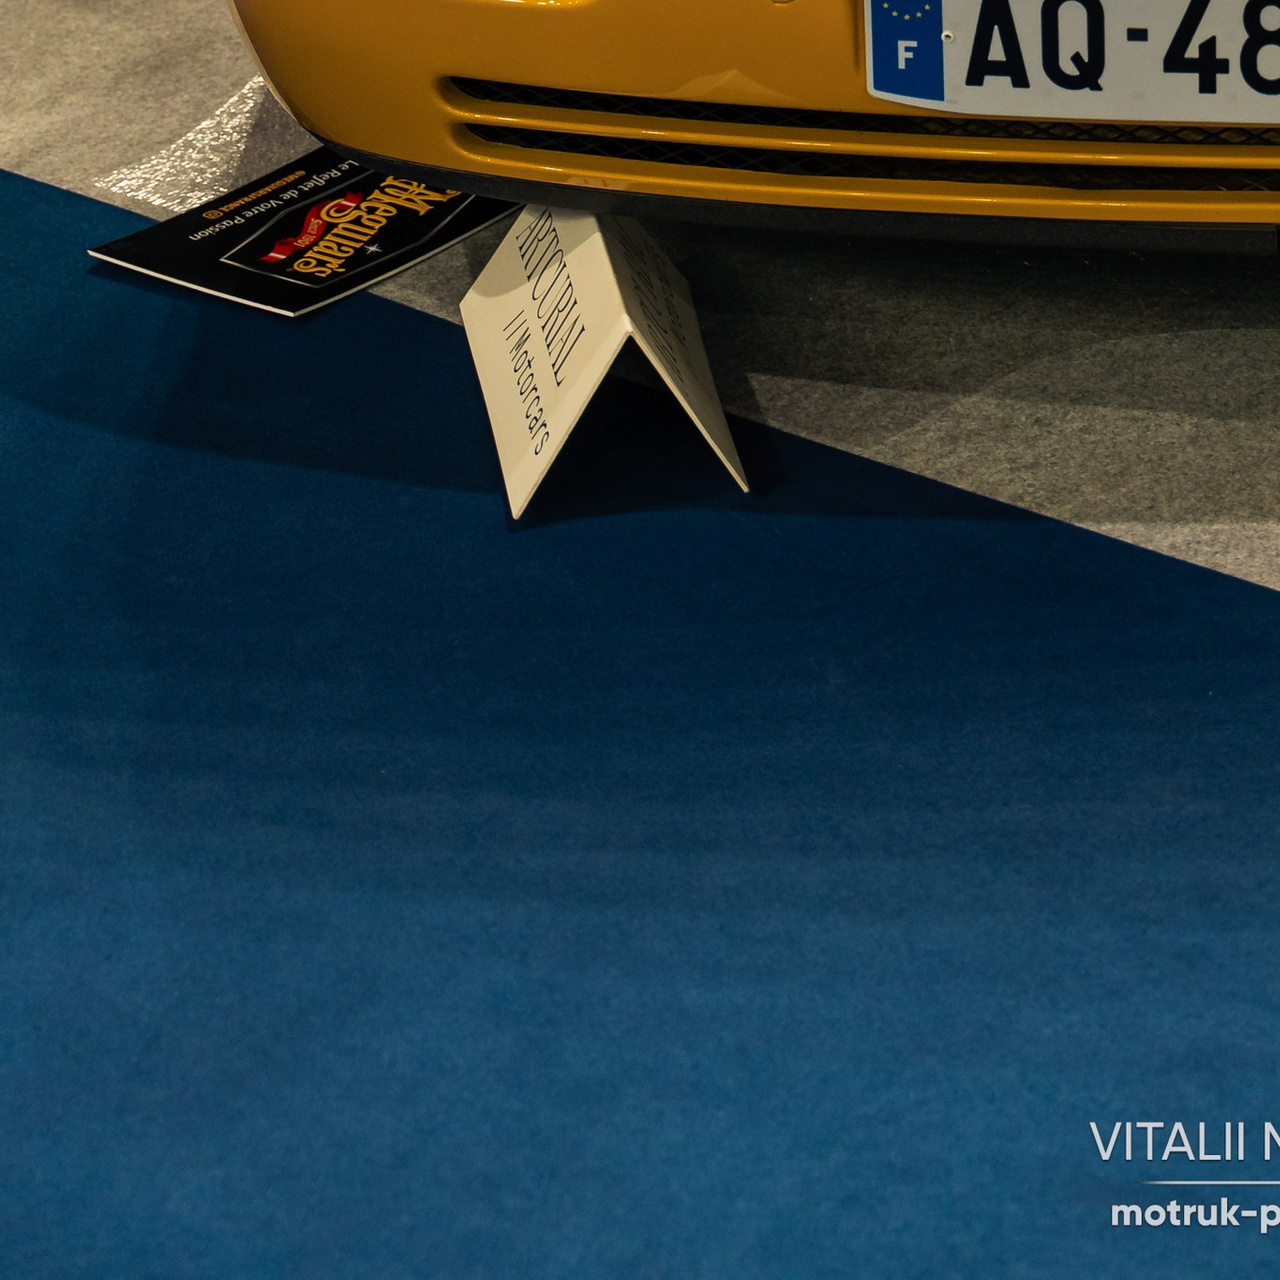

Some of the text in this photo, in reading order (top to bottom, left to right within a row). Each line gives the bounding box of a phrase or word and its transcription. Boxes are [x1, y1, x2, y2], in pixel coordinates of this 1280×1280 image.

[897, 40, 918, 69] F
[188, 160, 360, 241] Le Reflet de Votre Passion
[293, 176, 461, 278] Meguiar's
[304, 218, 323, 239] Since
[515, 207, 586, 388] ARTCURIAL
[509, 325, 551, 456] Motorcars
